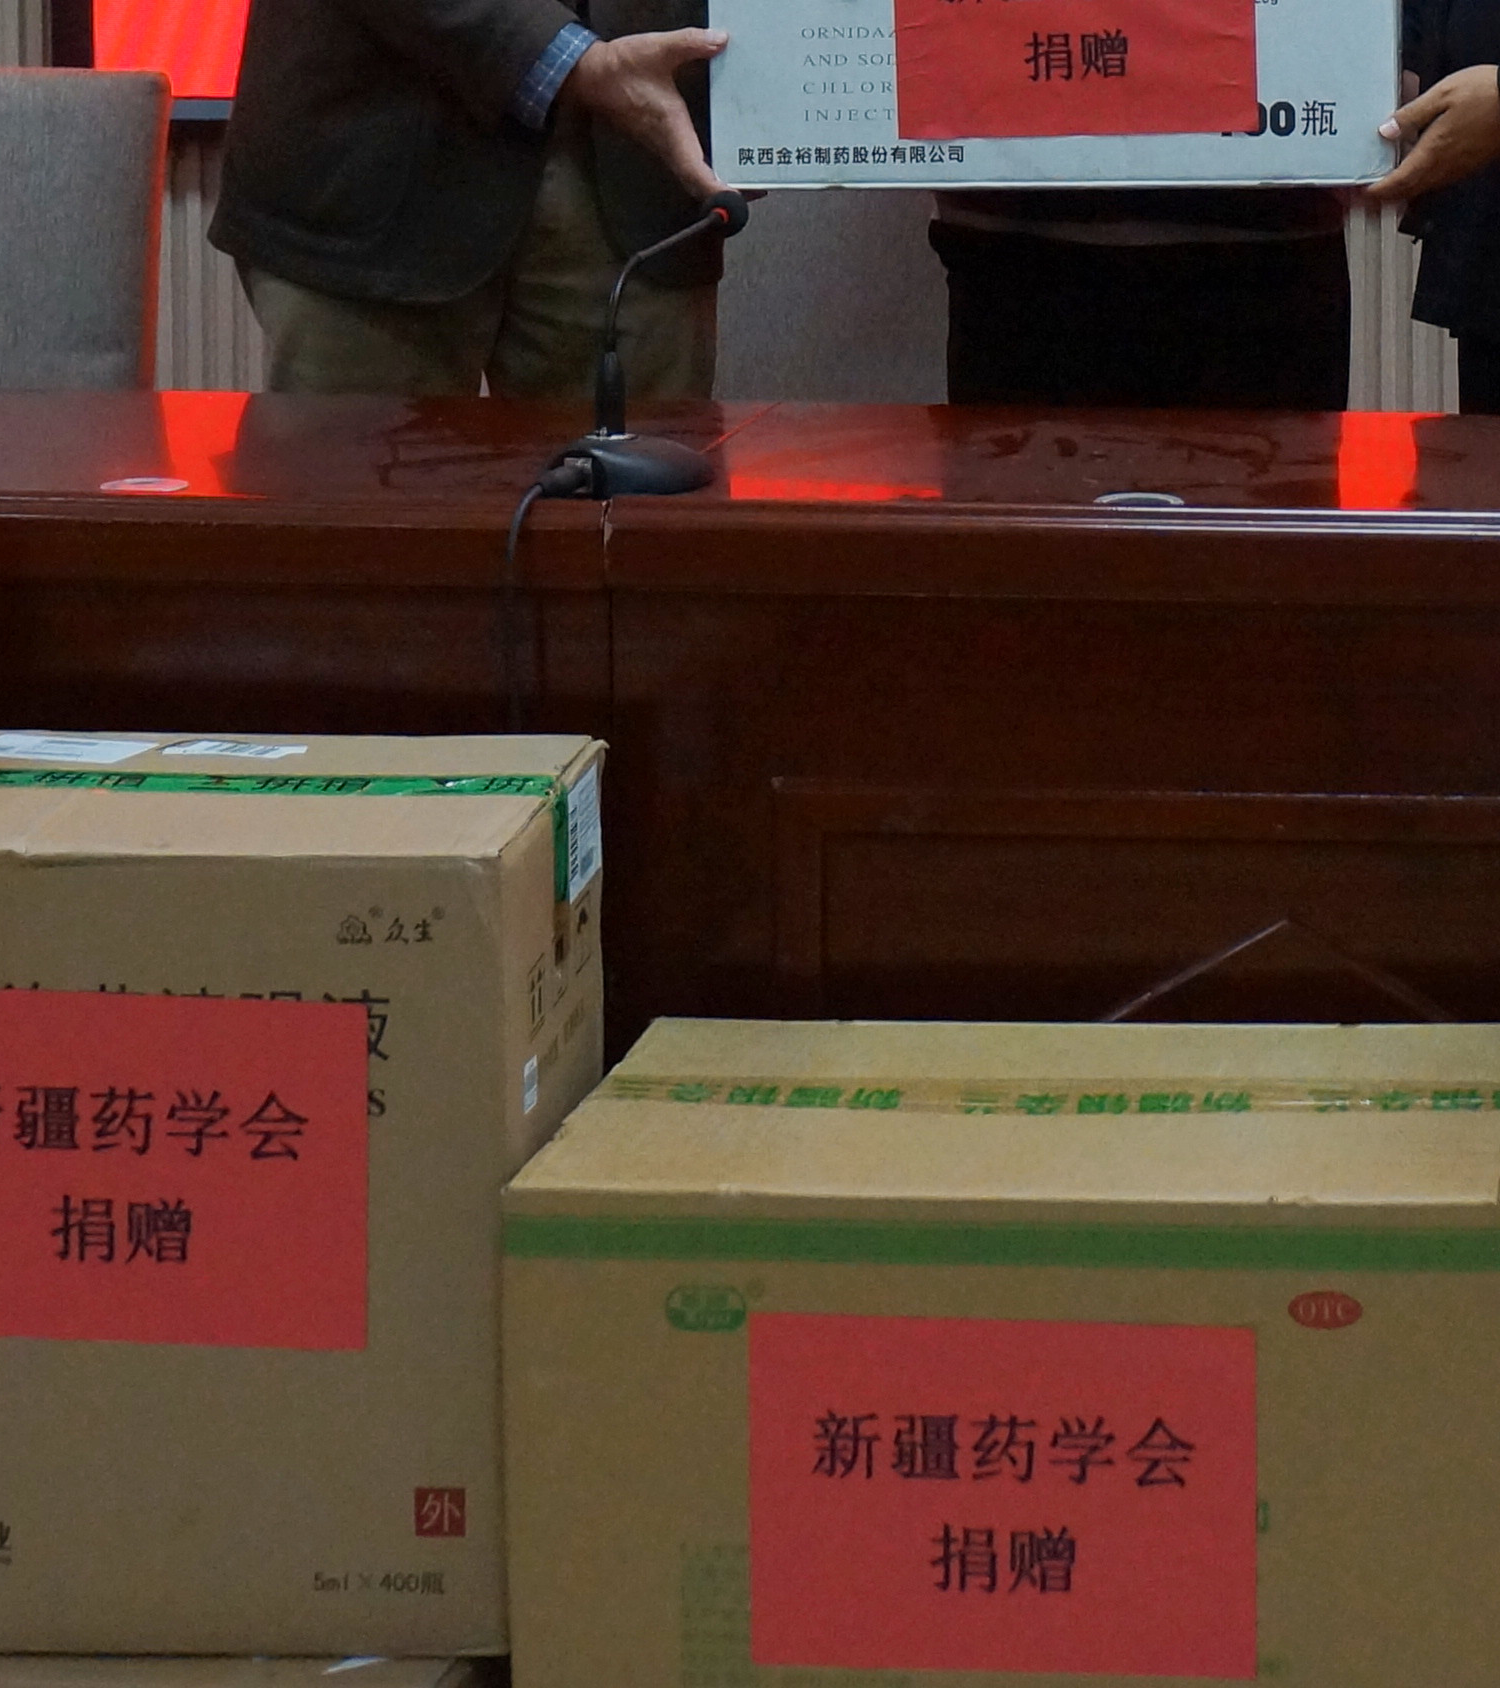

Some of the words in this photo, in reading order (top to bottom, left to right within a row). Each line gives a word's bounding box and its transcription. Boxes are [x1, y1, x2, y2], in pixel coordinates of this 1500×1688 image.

[803, 53, 848, 67] AND
[1024, 28, 1129, 82] 捐赠
[738, 144, 965, 166] 陕西金裕制药股份有限公司
[51, 1194, 193, 1264] 捐赠
[813, 1411, 1195, 1488] 新疆药学会
[419, 1491, 462, 1534] 外
[931, 1523, 1077, 1594] 捐赠
